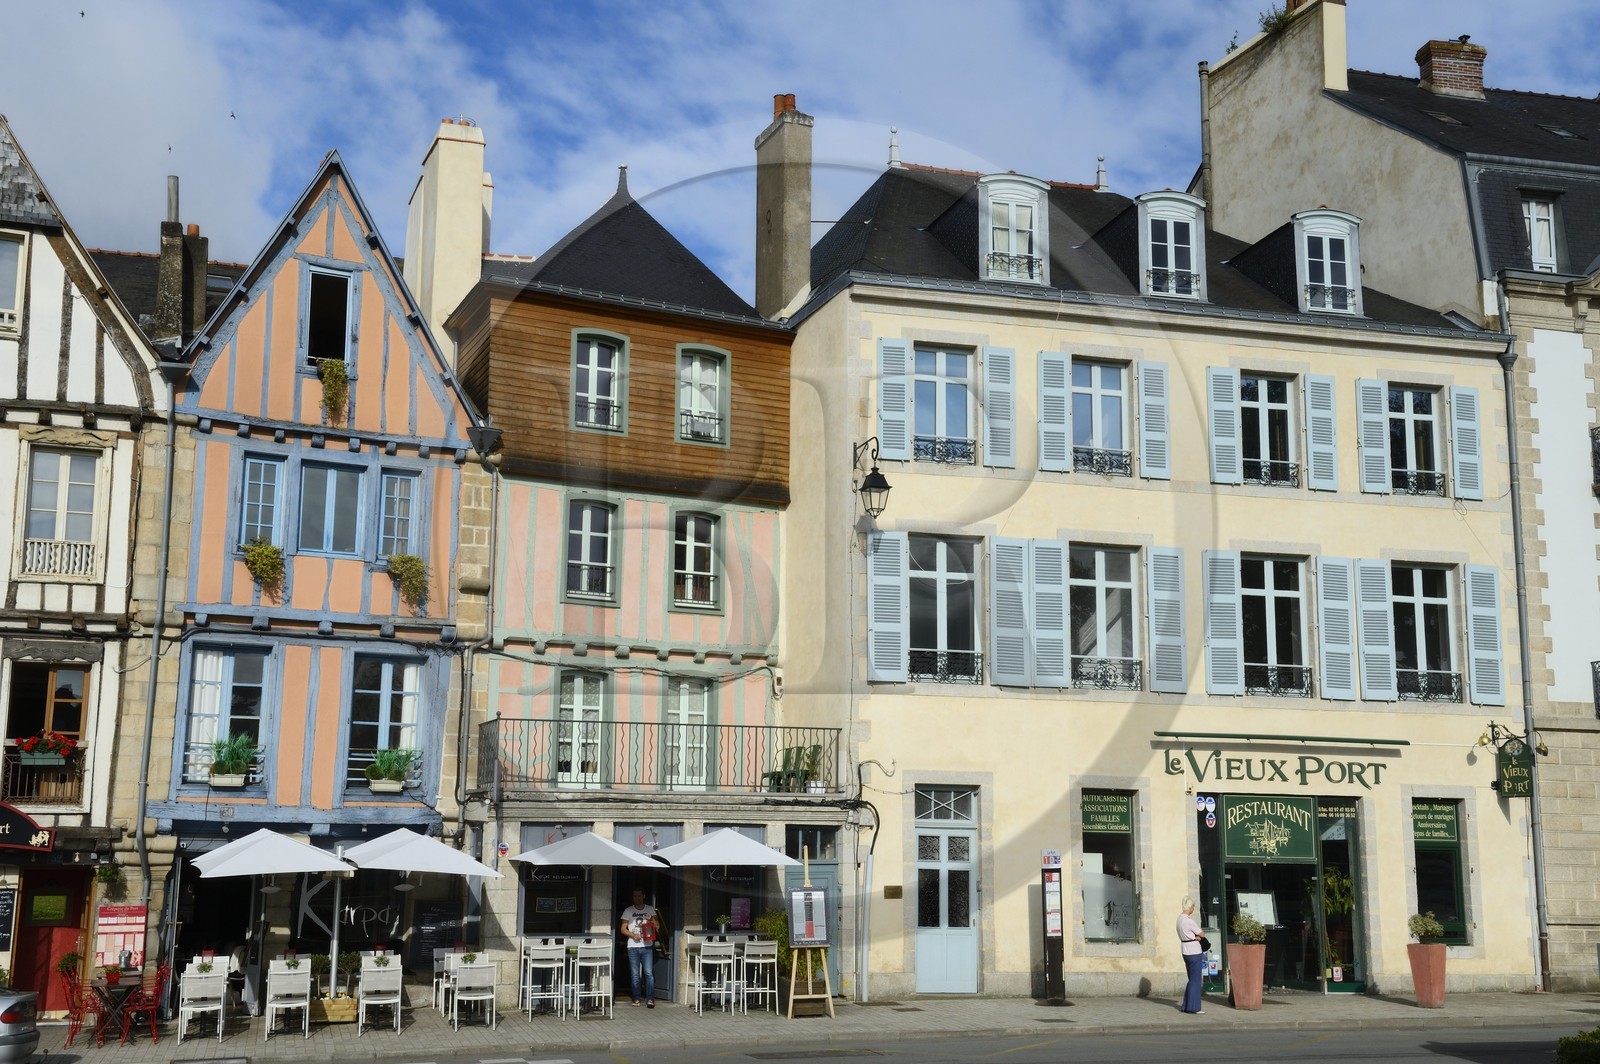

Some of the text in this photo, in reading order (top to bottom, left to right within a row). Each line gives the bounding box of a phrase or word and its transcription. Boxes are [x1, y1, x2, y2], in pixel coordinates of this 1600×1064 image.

[1294, 756, 1387, 790] PORT
[1082, 794, 1128, 803] AUTOCARISTES
[1083, 804, 1128, 813] ASSOCIATIONS
[1412, 803, 1429, 811] ocktails
[1090, 814, 1120, 822] FAMILLES
[1227, 801, 1311, 832] RESTAURANT
[1417, 821, 1447, 829] Anniversaires
